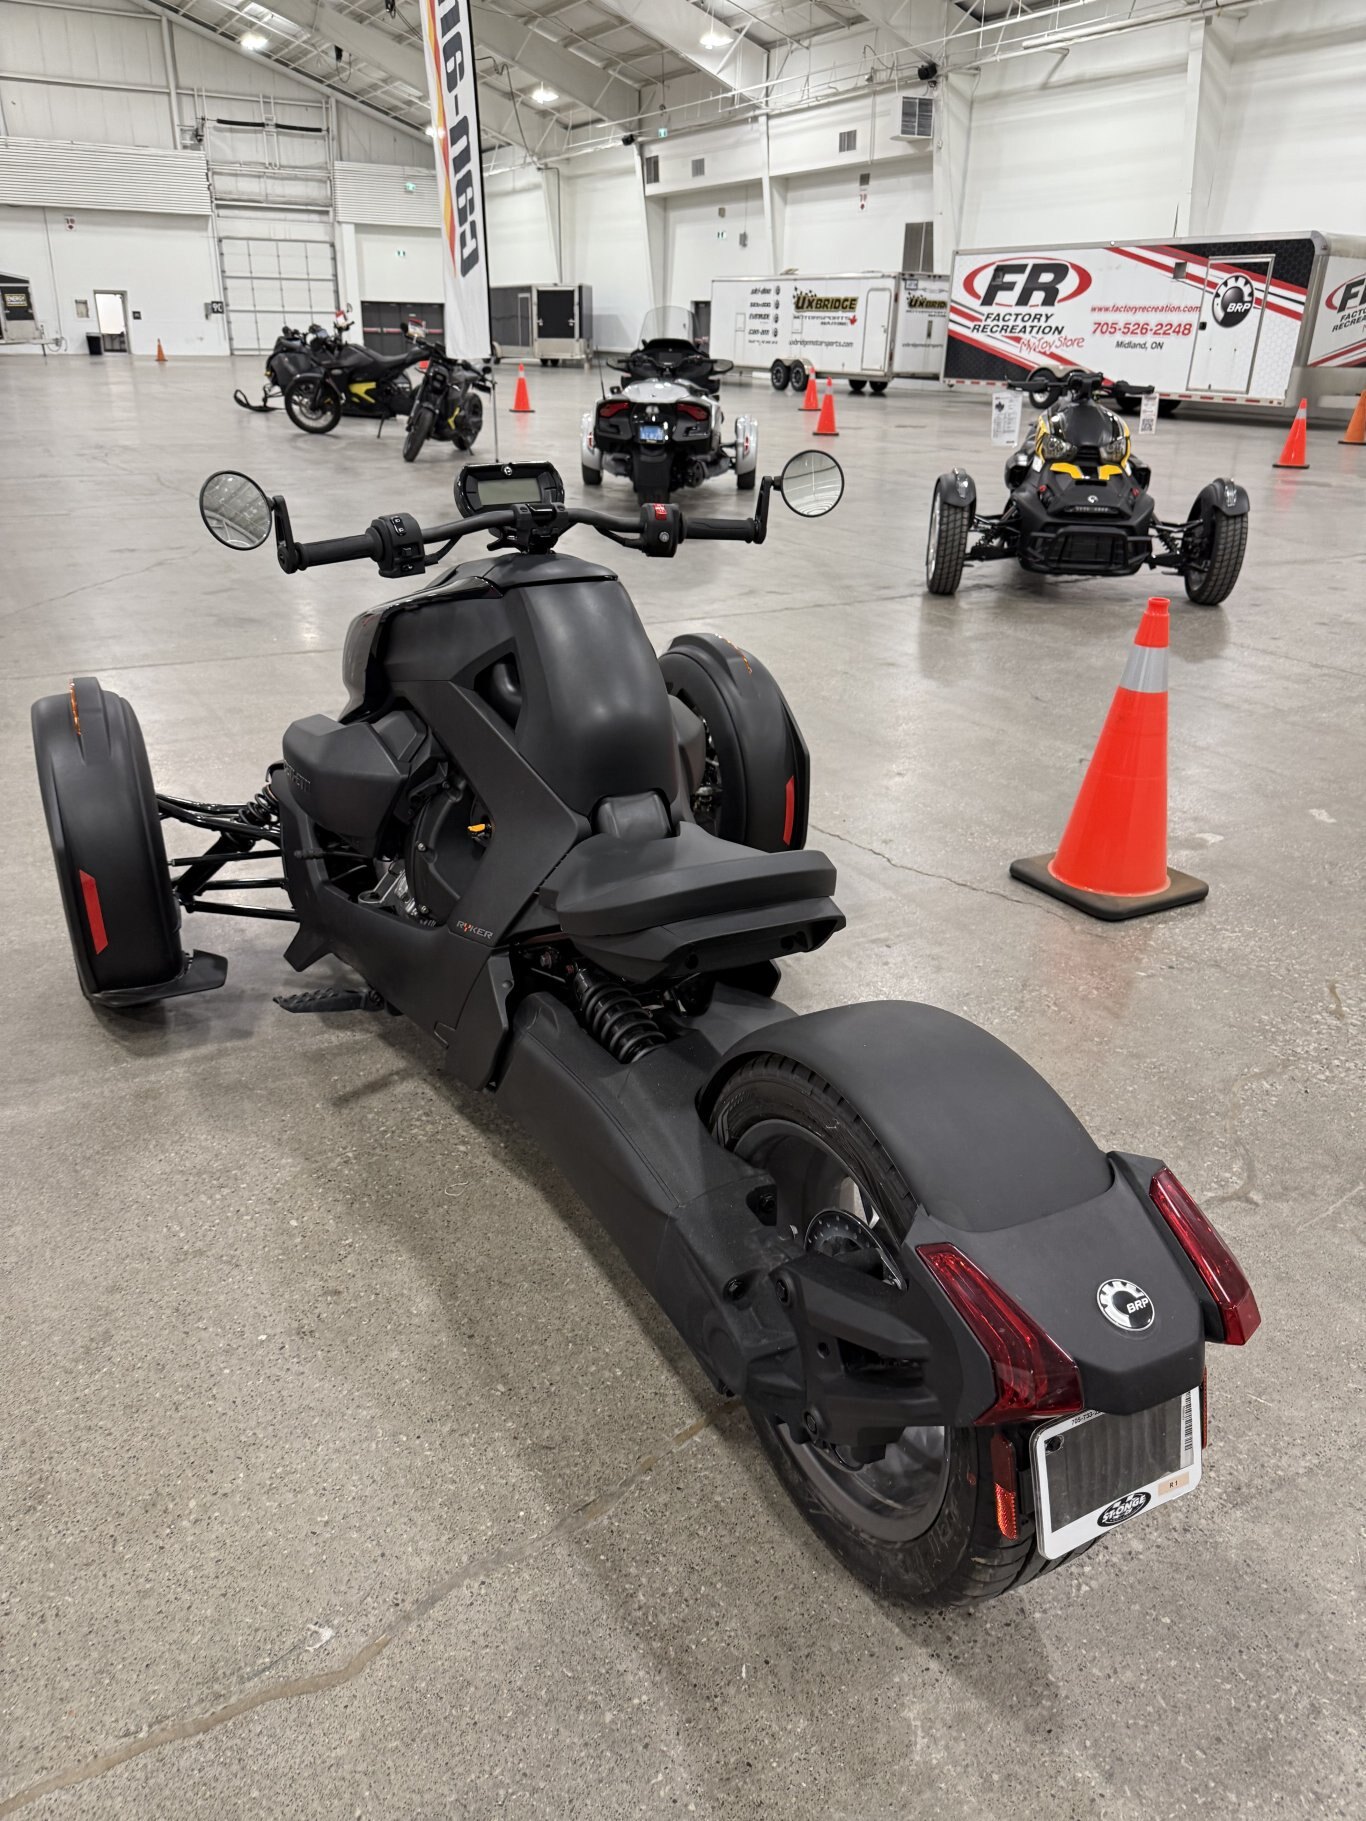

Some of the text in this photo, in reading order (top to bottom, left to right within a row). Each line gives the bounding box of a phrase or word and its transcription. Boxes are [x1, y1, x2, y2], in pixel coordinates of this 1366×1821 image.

[980, 263, 1070, 307] FR
[795, 295, 858, 311] UXBRIDGE
[1091, 303, 1201, 314] www.factoryrecreation.com
[1226, 302, 1251, 313] BRP
[984, 312, 1055, 323] FACTORY
[971, 324, 1065, 335] RECREATION
[1092, 322, 1193, 336] 705-526-2248
[1019, 334, 1086, 354] My Toy Store
[1115, 341, 1164, 351] Midland, ON
[457, 921, 493, 939] RYKER
[1126, 1297, 1149, 1313] BRP
